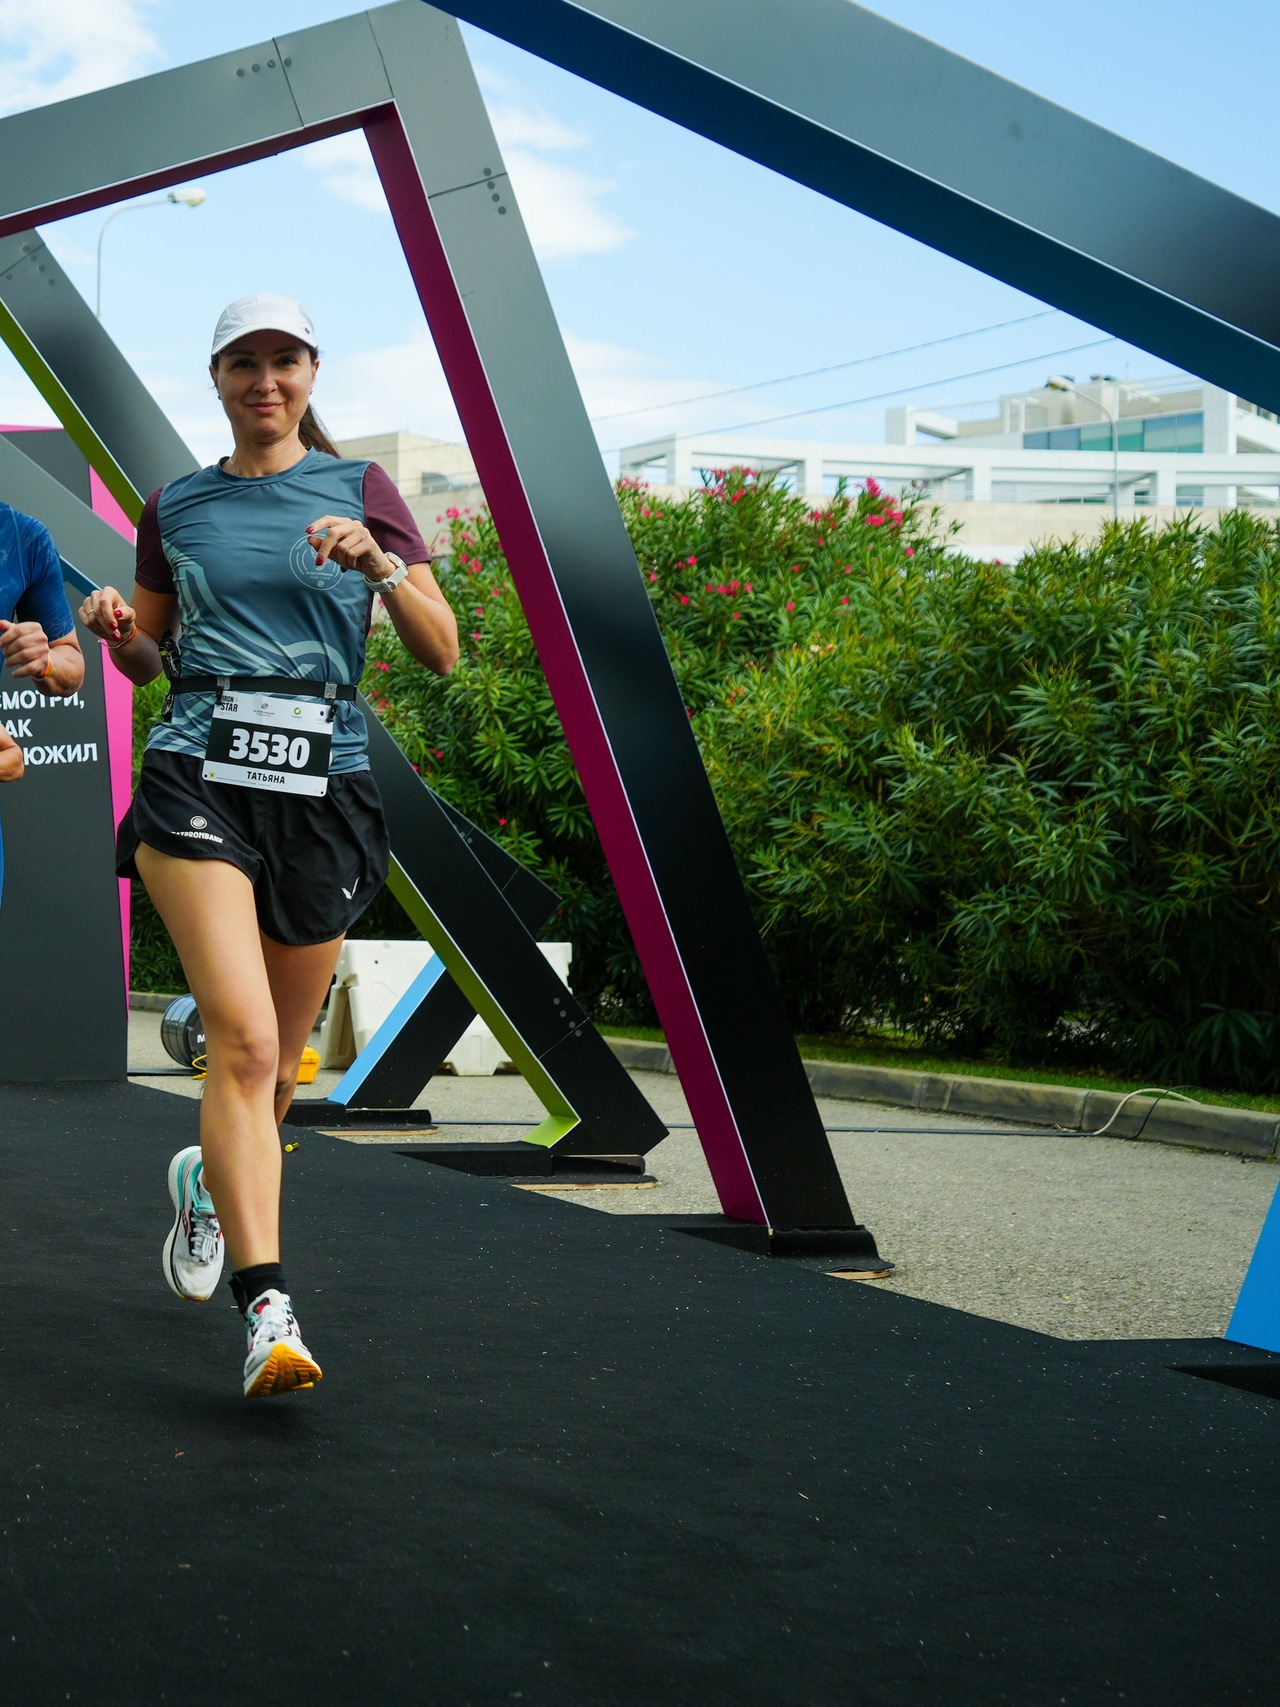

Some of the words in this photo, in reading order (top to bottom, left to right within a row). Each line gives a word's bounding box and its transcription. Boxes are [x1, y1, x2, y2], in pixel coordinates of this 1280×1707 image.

[220, 702, 239, 712] STAR
[5, 718, 34, 738] АК
[22, 742, 98, 766] ЮЖИЛ
[228, 728, 311, 769] 3530
[246, 771, 286, 785] ТАТЬЯНА
